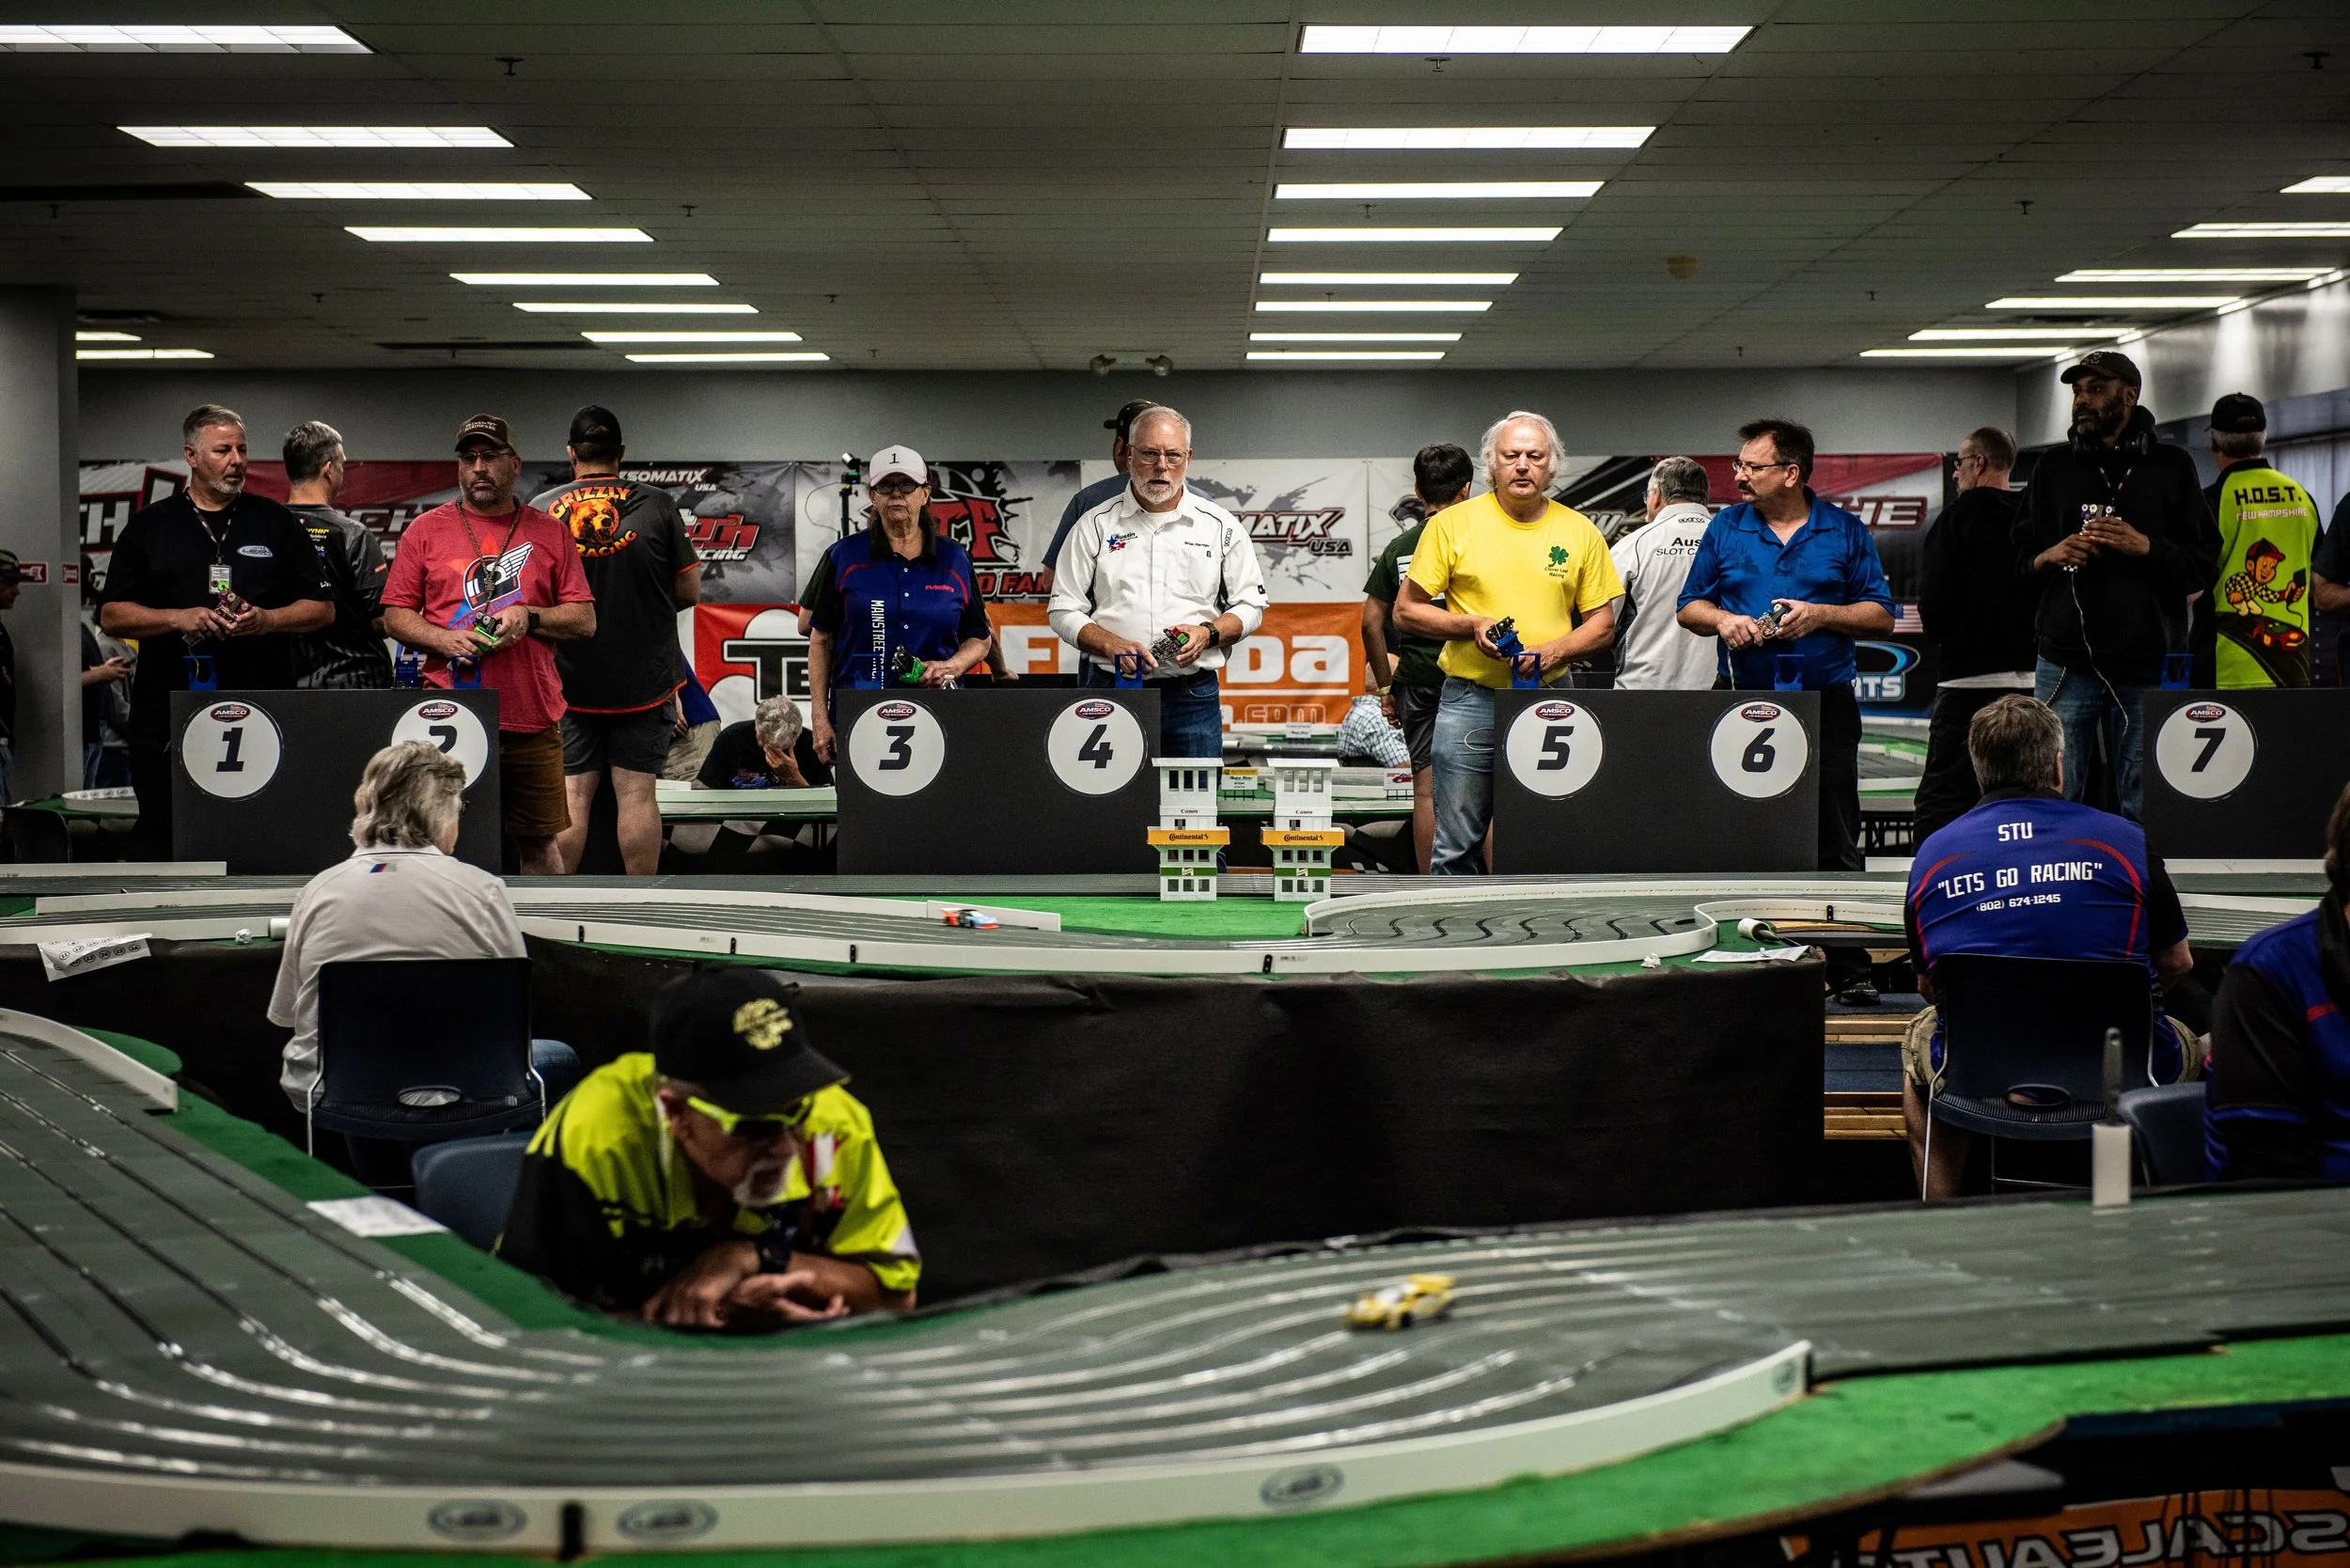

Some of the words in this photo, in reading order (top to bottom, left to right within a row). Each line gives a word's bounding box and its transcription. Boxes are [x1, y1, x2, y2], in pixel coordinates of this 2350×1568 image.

[889, 453, 901, 464] 1
[694, 483, 716, 493] USA
[2233, 486, 2303, 507] H.O.S.T.
[548, 486, 631, 519] GRIZZLY
[2258, 507, 2308, 519] HAMPSHIRE
[576, 528, 639, 557] RACING
[1308, 539, 1353, 555] USA
[1656, 548, 1684, 557] SLOT
[215, 727, 244, 772] 1
[878, 725, 916, 770] 3
[1077, 724, 1114, 769] 4
[1537, 726, 1574, 770] 5
[1741, 728, 1776, 773] 6
[2191, 728, 2227, 773] 7
[1168, 833, 1204, 841] Continental
[1284, 834, 1319, 842] Continental
[1998, 822, 2034, 842] STU
[1996, 868, 2019, 888] GO
[2030, 861, 2103, 884] RACING"
[2009, 893, 2061, 908] 674-1245
